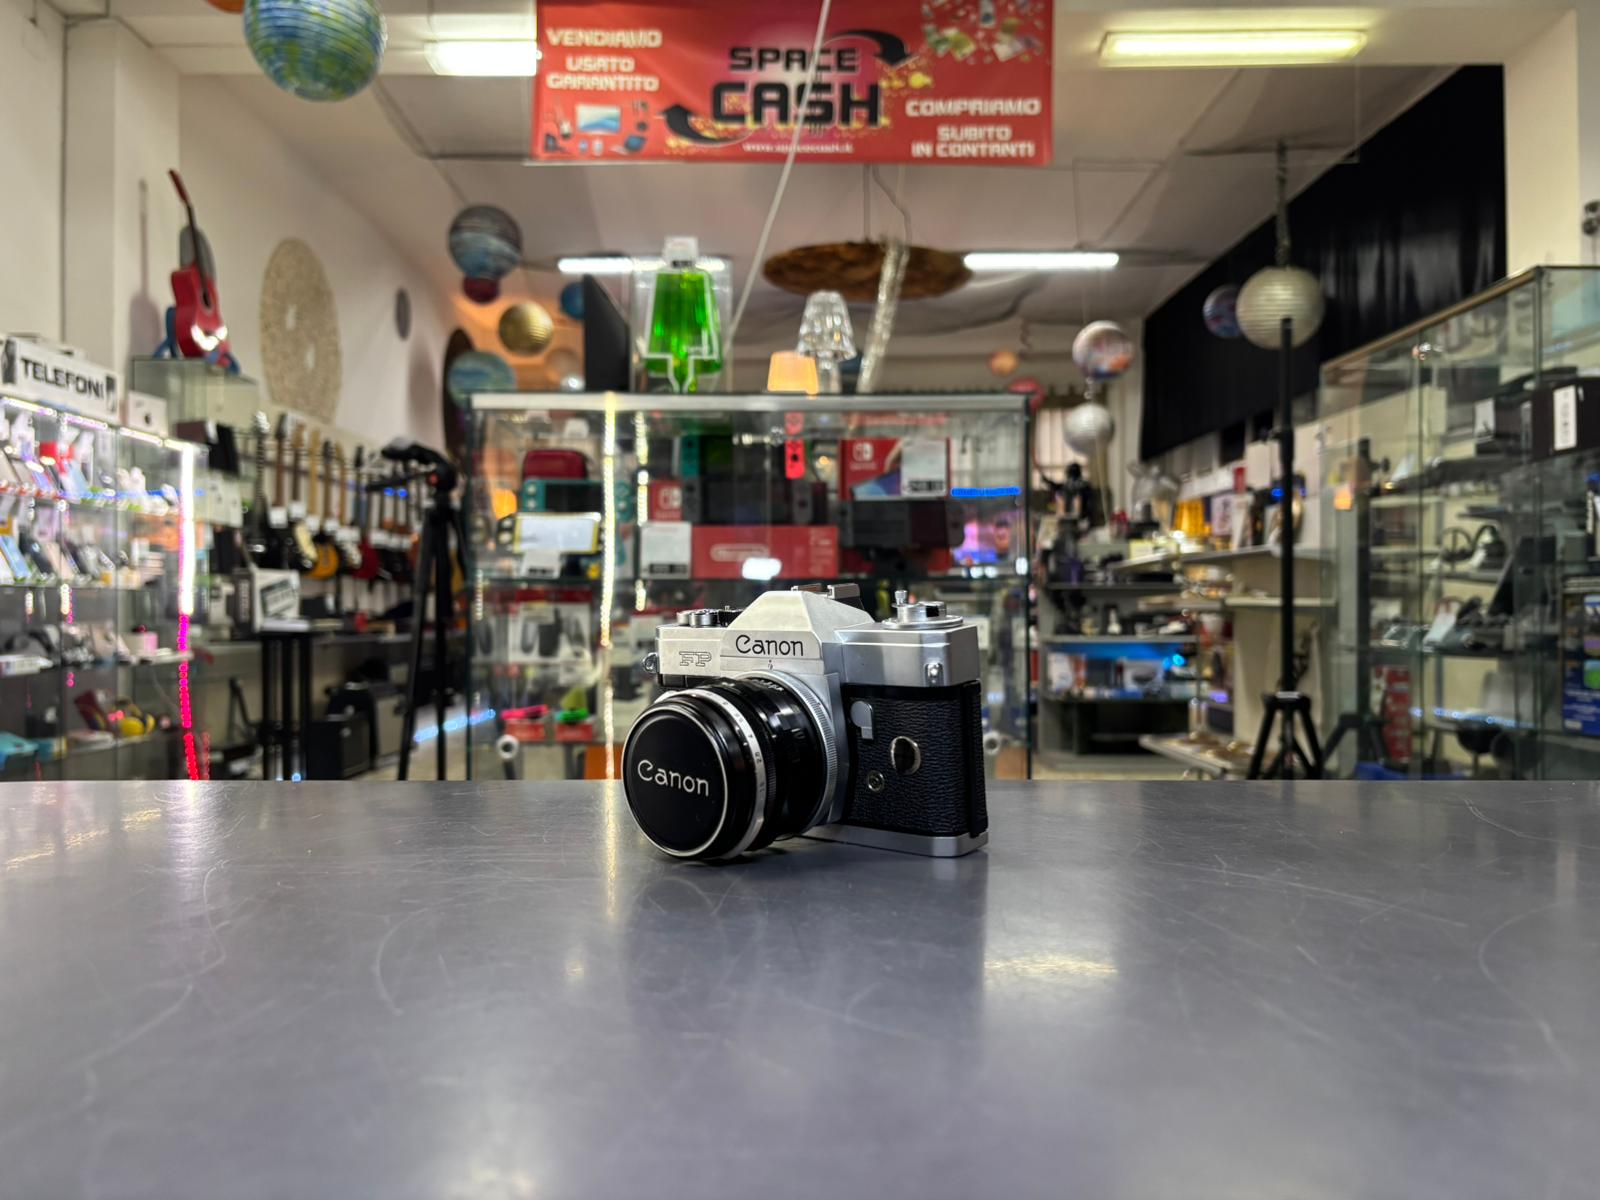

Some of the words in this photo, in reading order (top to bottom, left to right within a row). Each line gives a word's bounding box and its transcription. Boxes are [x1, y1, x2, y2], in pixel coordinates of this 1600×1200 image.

[545, 28, 663, 48] VENDIAMO
[565, 55, 635, 73] USATO
[729, 47, 857, 72] SPACE
[546, 73, 660, 92] GARANTITO
[712, 82, 879, 126] CASH
[905, 98, 1042, 117] COMPRIAMO
[937, 125, 1012, 142] SUBITO
[911, 142, 932, 158] IN
[936, 142, 1035, 158] CONTANTI
[20, 357, 104, 399] TELEFONI
[735, 634, 804, 657] Canon
[679, 651, 712, 667] FP
[637, 760, 709, 797] Canon
